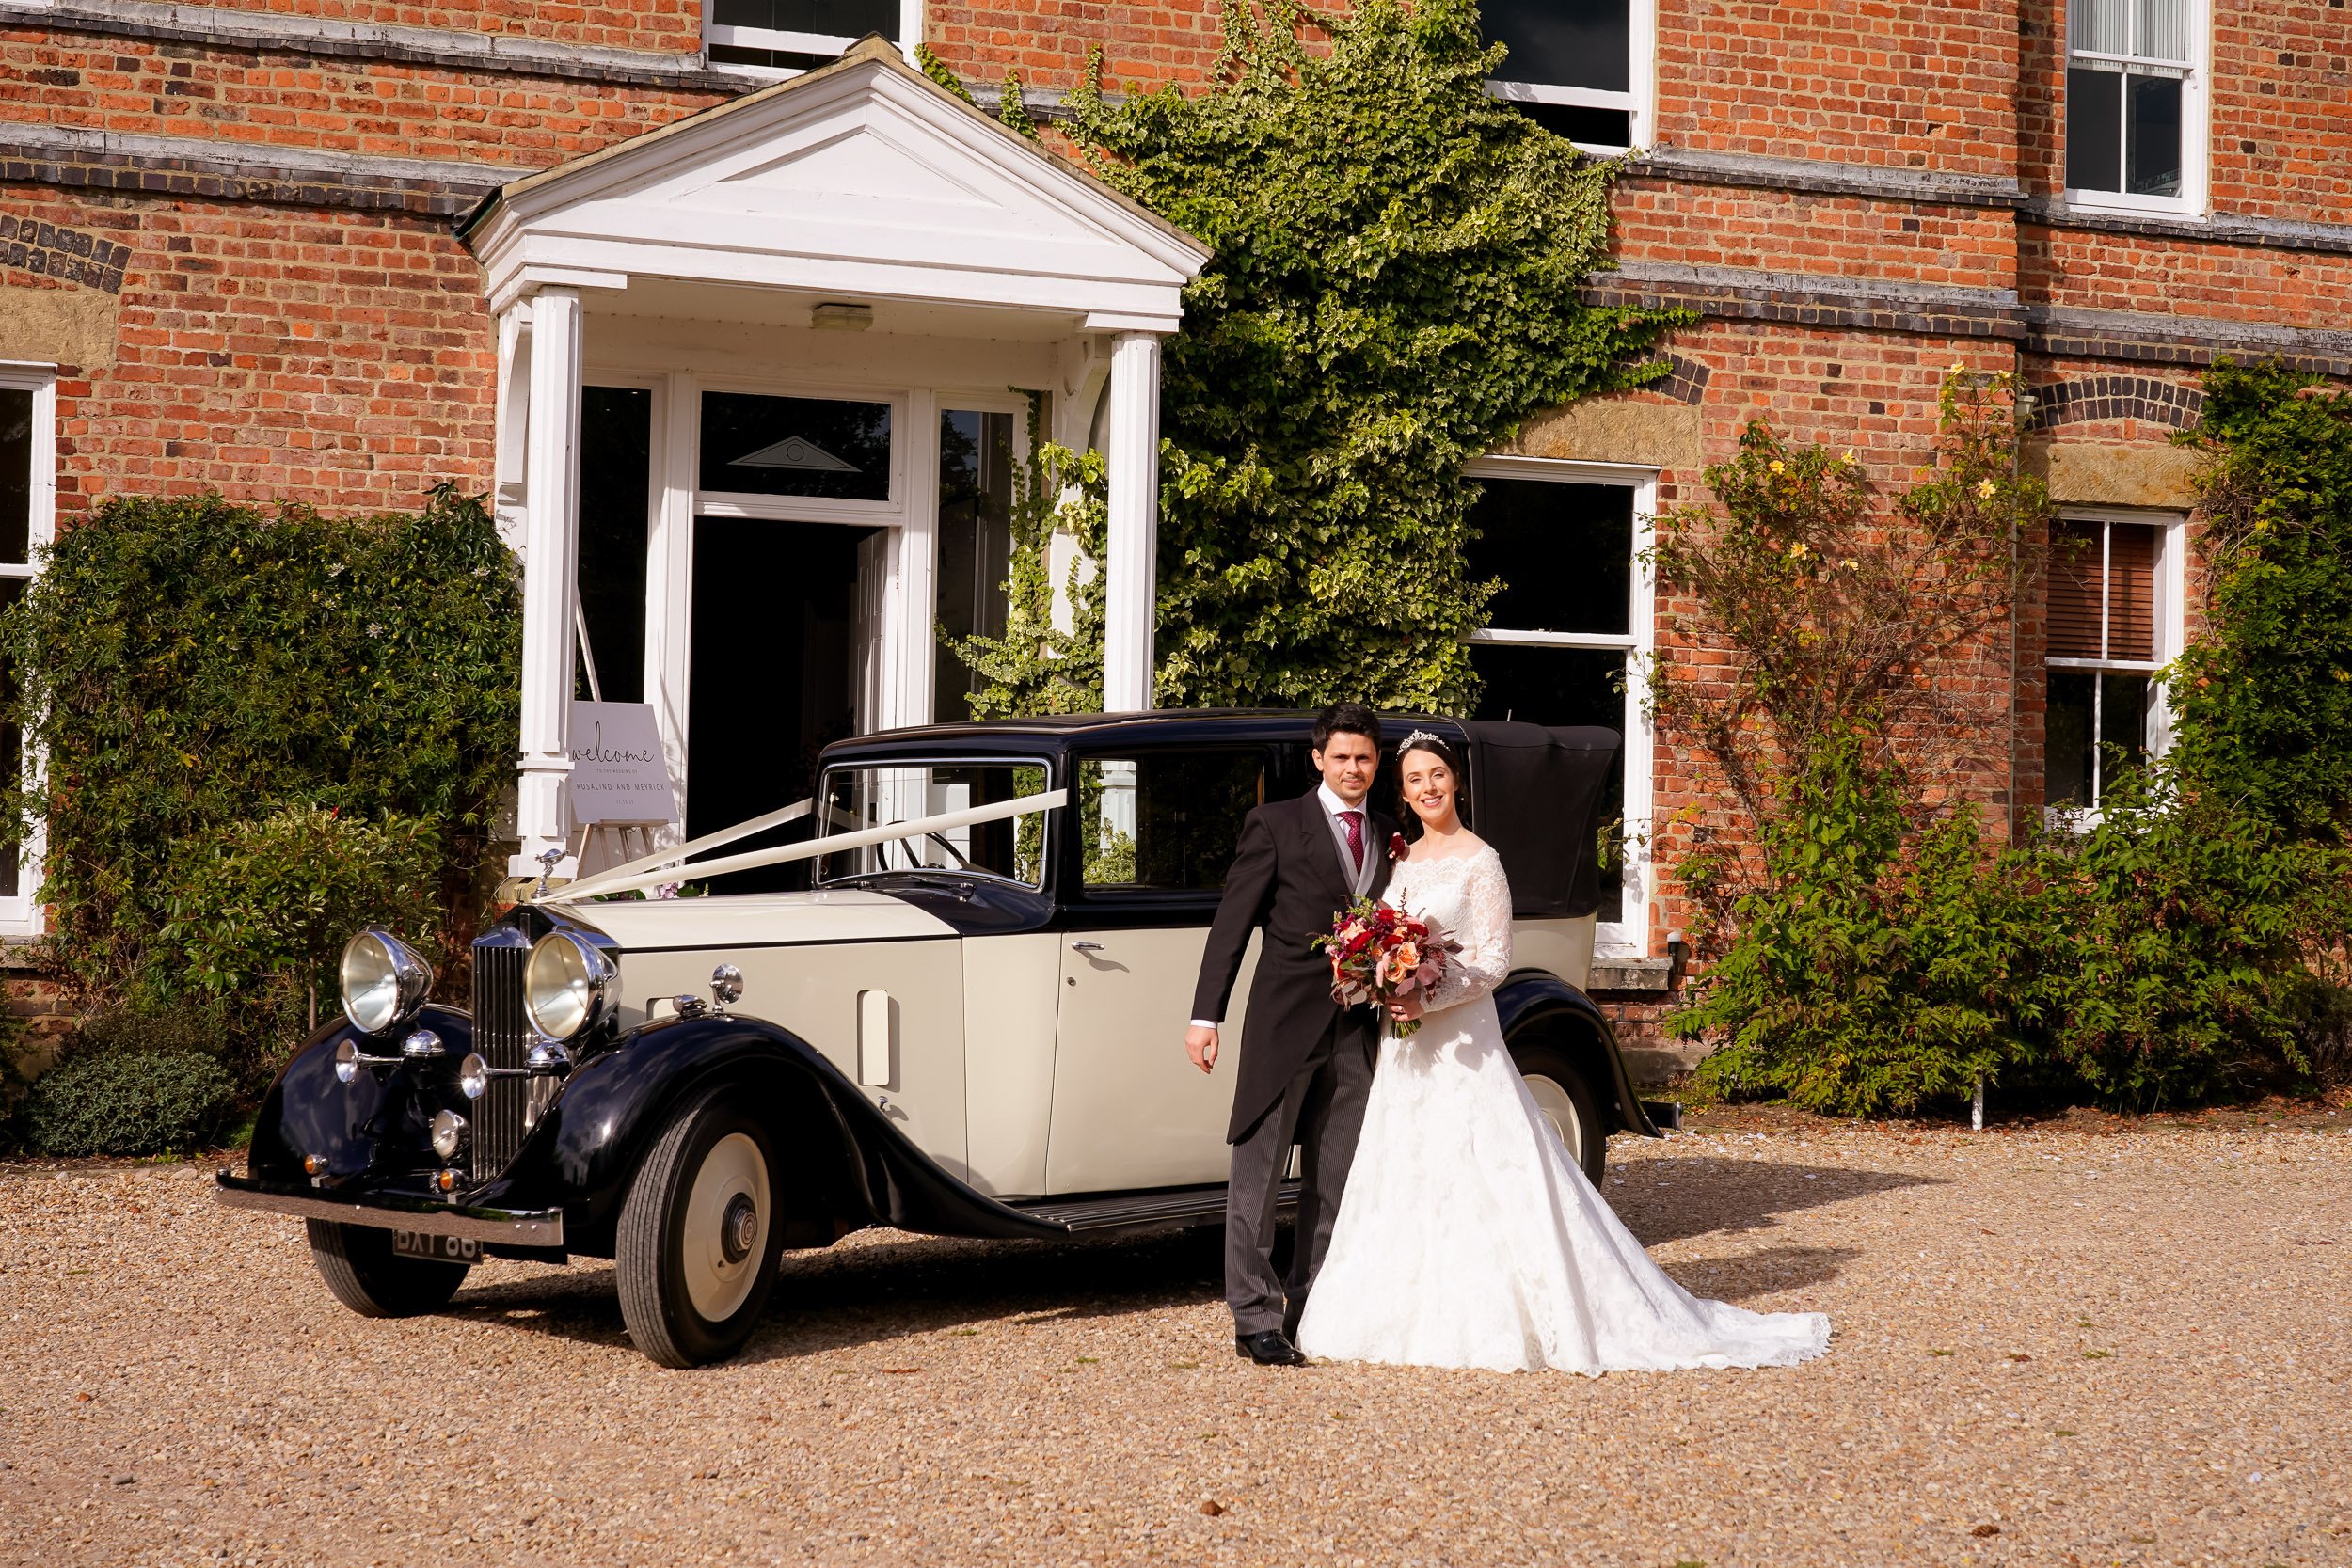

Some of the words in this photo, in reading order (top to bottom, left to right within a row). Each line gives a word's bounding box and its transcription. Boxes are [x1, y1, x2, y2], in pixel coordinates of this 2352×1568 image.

[572, 721, 655, 763] welcome
[576, 783, 612, 791] ROSALIND
[616, 783, 631, 791] AND
[634, 783, 665, 791] MEYRICK
